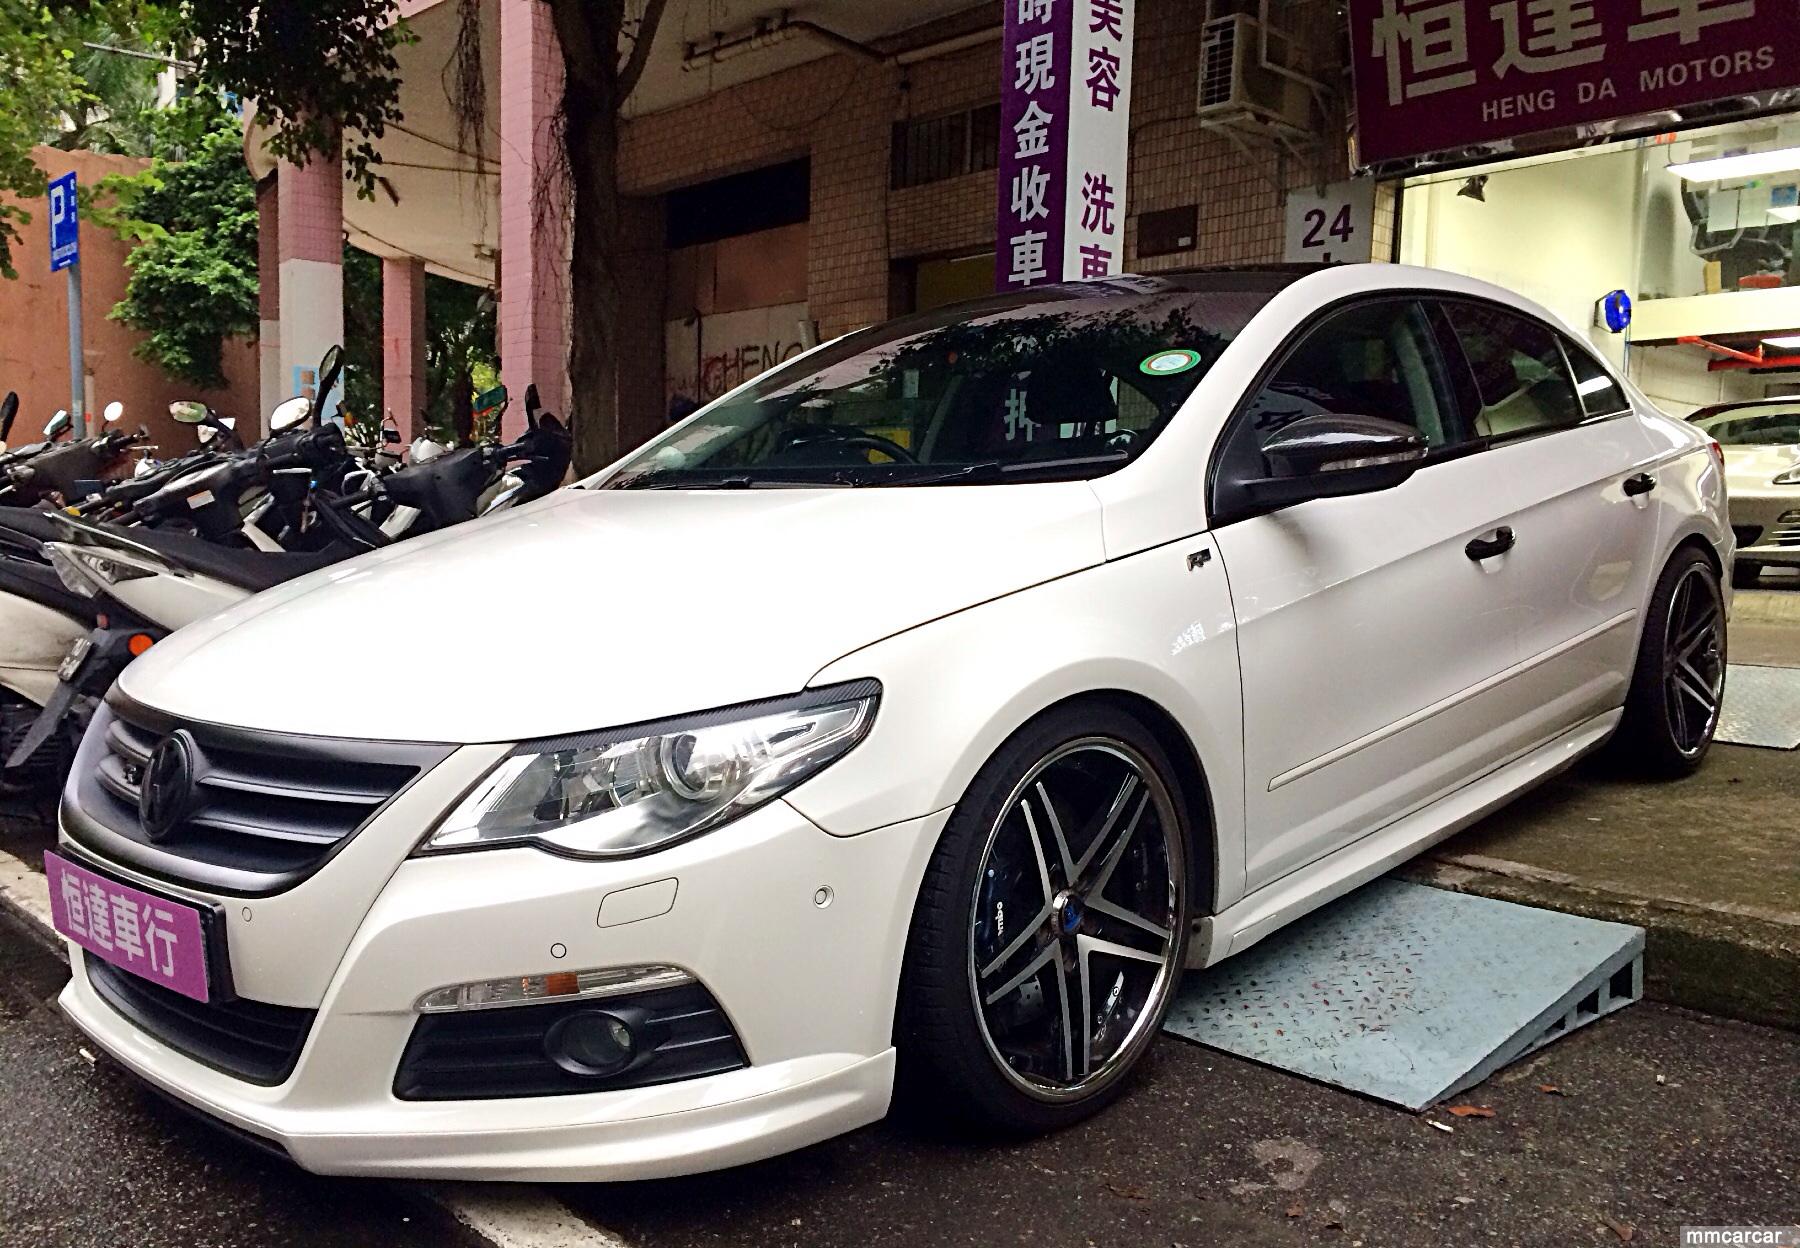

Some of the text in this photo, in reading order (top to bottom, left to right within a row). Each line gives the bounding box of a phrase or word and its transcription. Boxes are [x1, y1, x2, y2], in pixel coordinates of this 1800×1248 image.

[1482, 45, 1776, 122] HENG DA MOTORS
[51, 185, 65, 249] P
[1302, 204, 1354, 249] 24
[60, 867, 178, 977] 恒達車行
